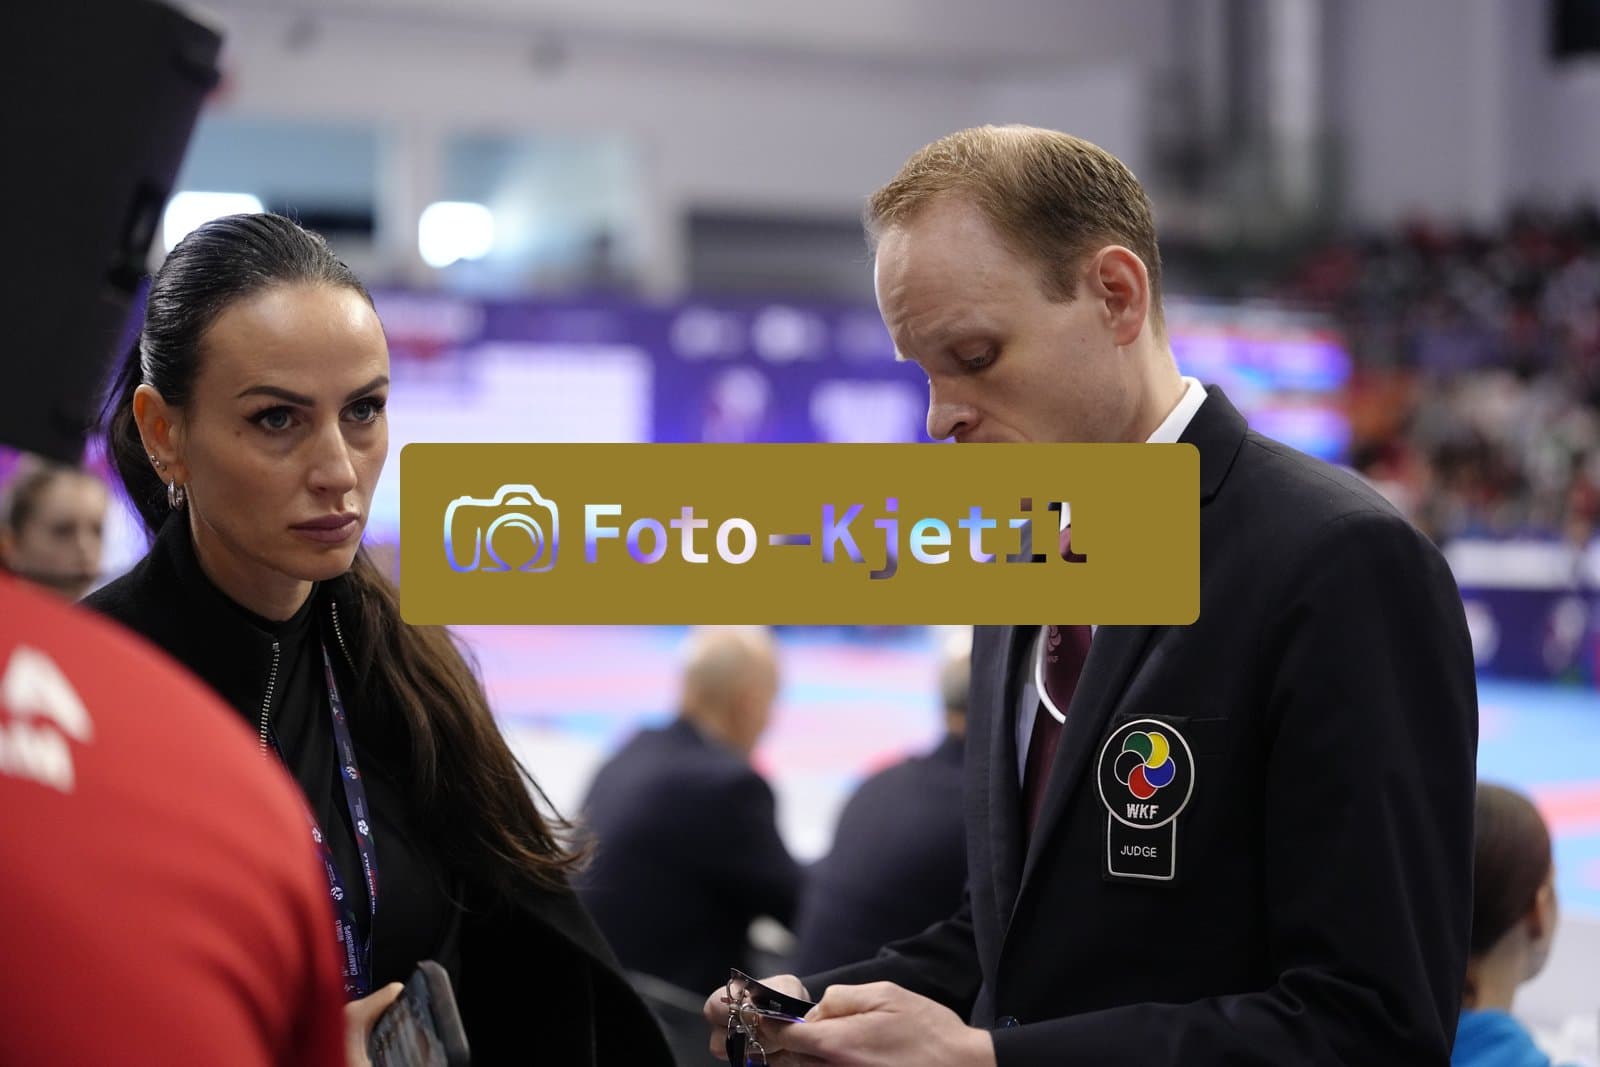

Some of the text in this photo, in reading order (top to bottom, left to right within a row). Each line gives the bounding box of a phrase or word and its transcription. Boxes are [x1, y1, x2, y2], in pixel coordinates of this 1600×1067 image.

[1126, 803, 1159, 819] WKF
[1120, 845, 1157, 858] JUDGE
[344, 924, 359, 976] CHAMPIONSHIPS
